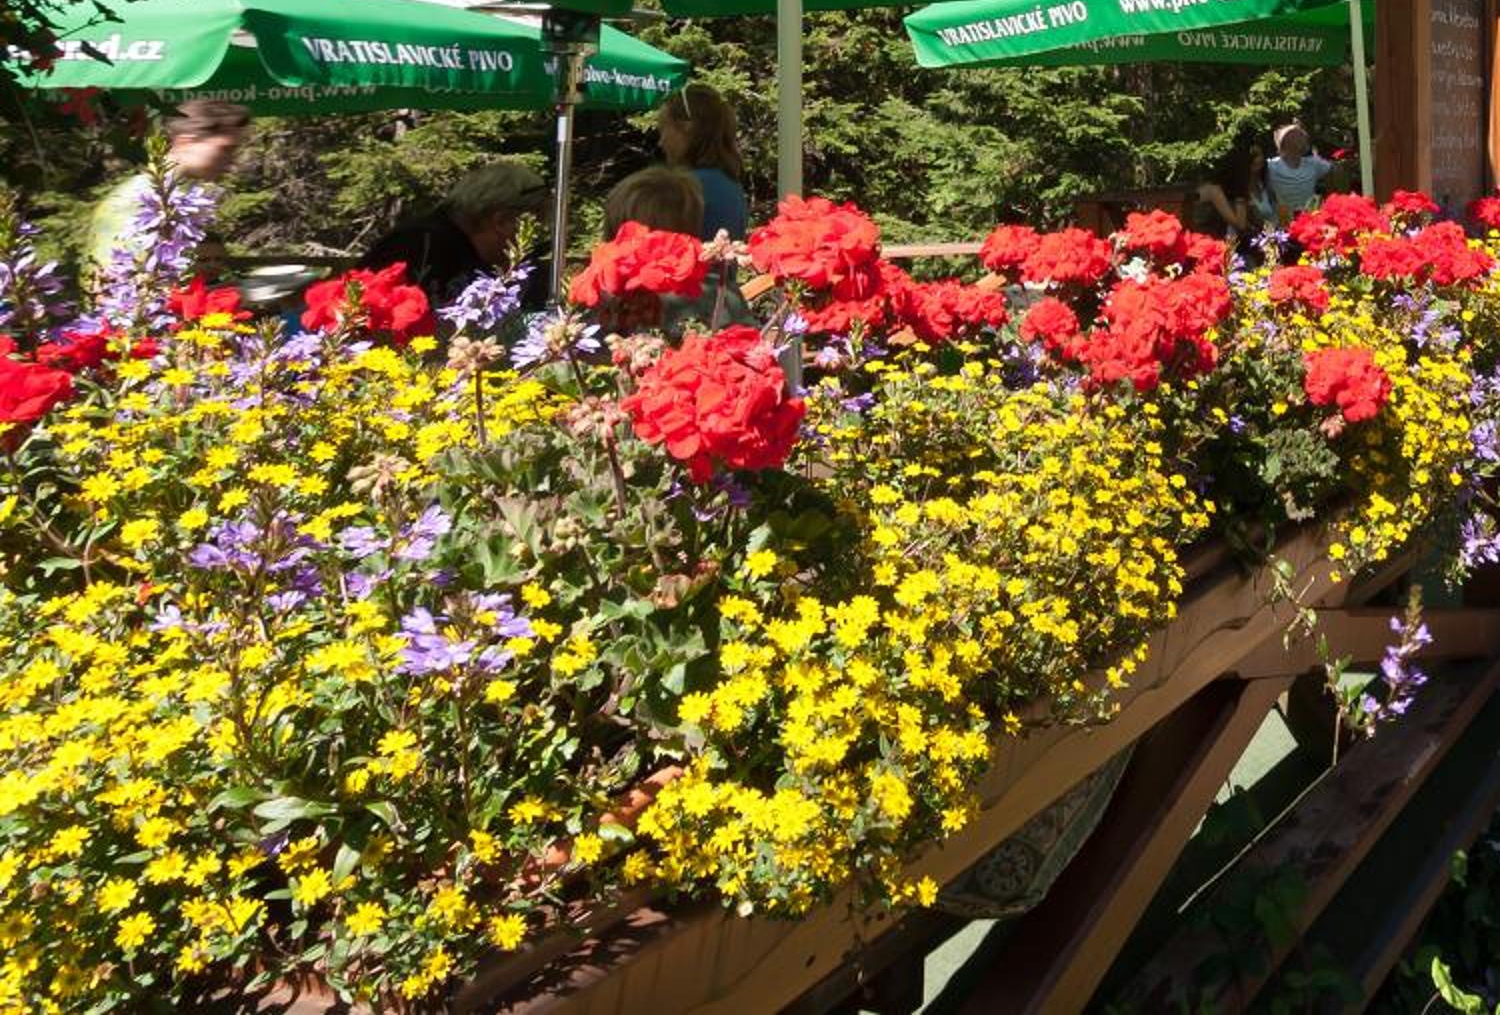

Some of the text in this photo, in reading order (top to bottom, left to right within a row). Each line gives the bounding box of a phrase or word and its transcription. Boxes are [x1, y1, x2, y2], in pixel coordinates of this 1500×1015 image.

[937, 5, 1046, 47] VRATISLAVICKÉ
[1048, 0, 1088, 31] PIVO
[303, 37, 513, 73] VRATISLAVICKÉ PIVO
